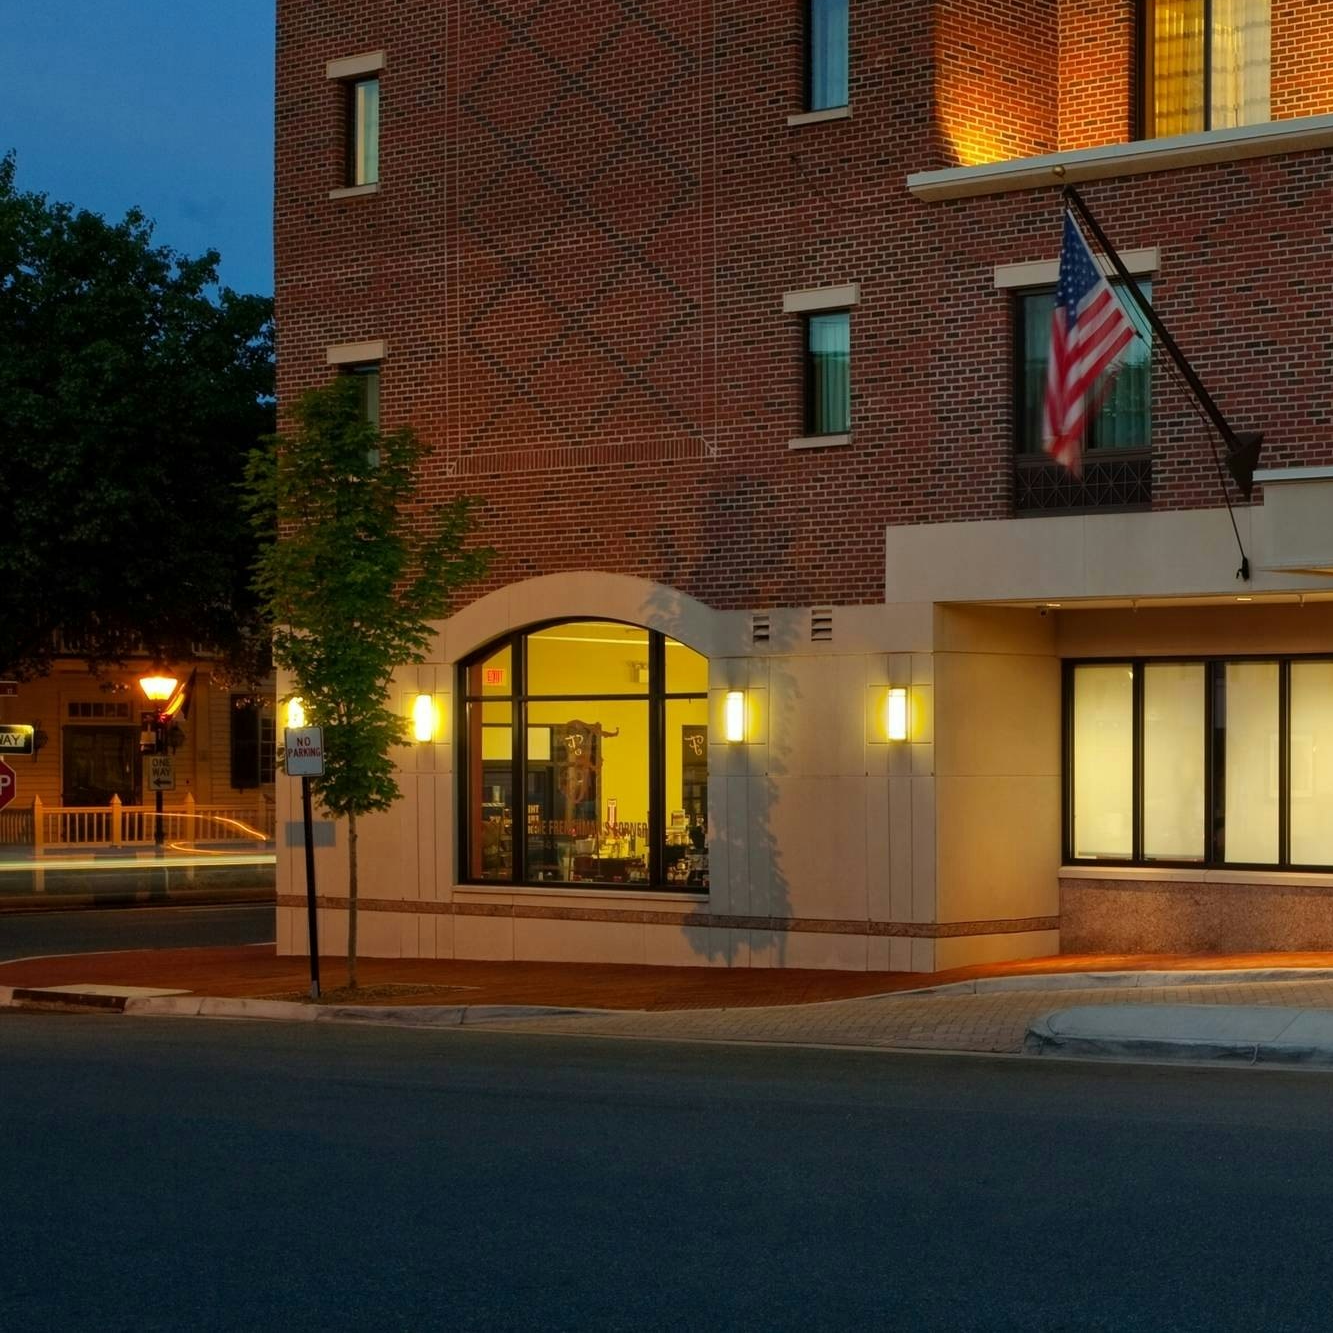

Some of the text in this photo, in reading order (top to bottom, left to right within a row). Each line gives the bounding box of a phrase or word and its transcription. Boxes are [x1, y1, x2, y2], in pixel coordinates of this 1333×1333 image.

[296, 736, 312, 747] NO
[287, 747, 321, 758] PARKING
[152, 757, 171, 767] ONE
[151, 767, 171, 777] WAY
